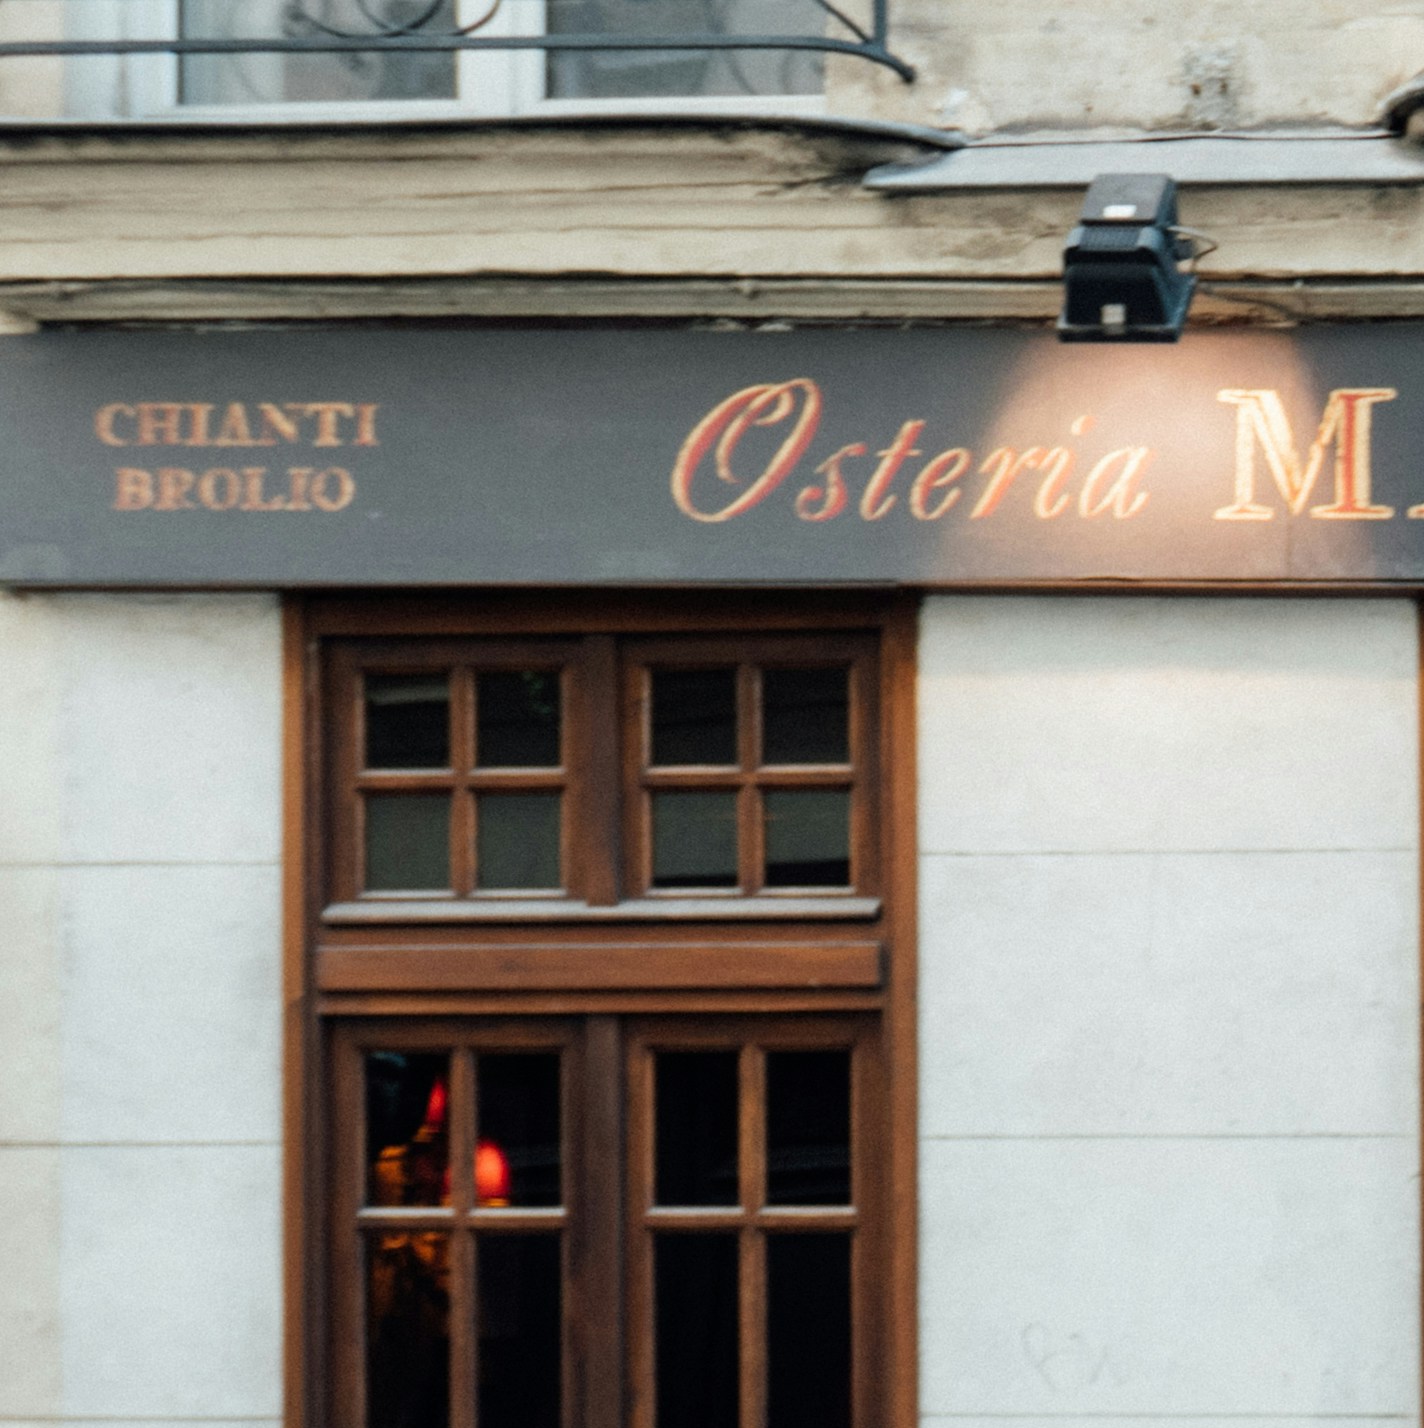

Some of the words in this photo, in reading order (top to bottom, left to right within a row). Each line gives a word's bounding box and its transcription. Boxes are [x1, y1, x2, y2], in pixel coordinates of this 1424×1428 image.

[95, 402, 379, 447] CHIANTI
[669, 379, 1151, 521] Osteria
[113, 467, 355, 512] BROLIO
